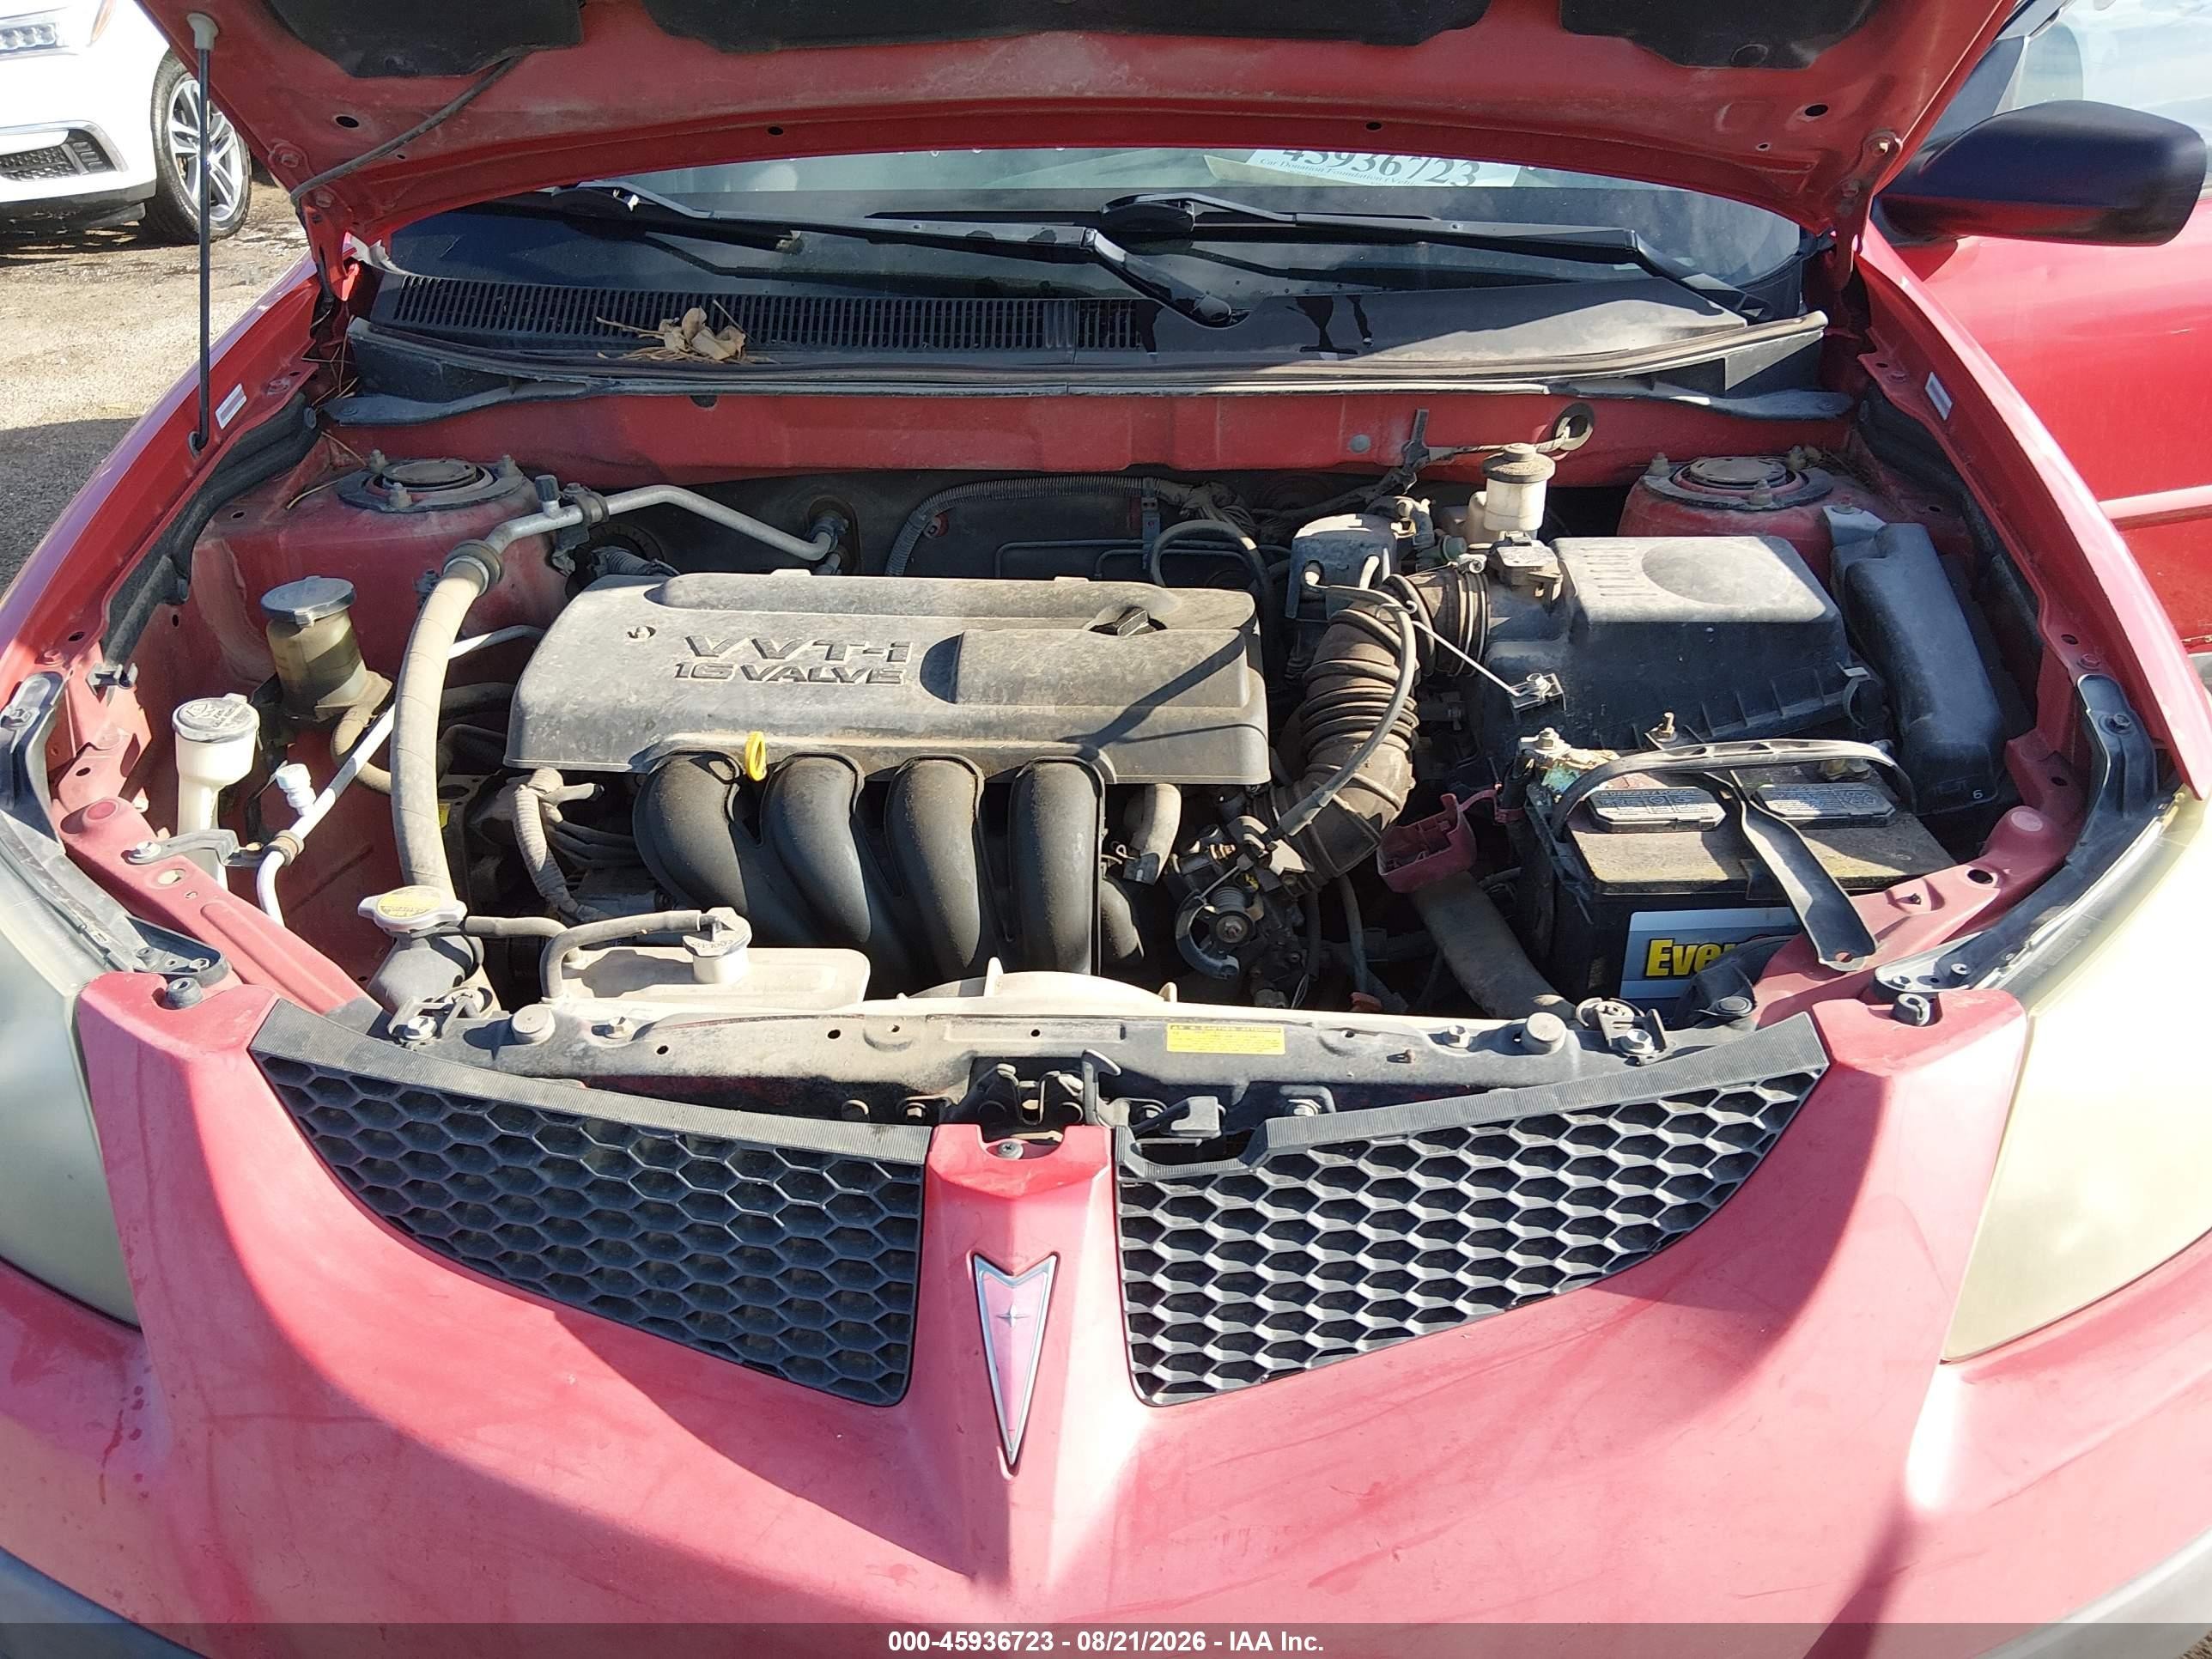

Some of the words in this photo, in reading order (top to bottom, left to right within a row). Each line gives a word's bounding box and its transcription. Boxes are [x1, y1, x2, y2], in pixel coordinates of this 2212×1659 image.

[674, 661, 737, 680] 16
[740, 664, 906, 686] VALVE
[1972, 789, 1984, 799] 6
